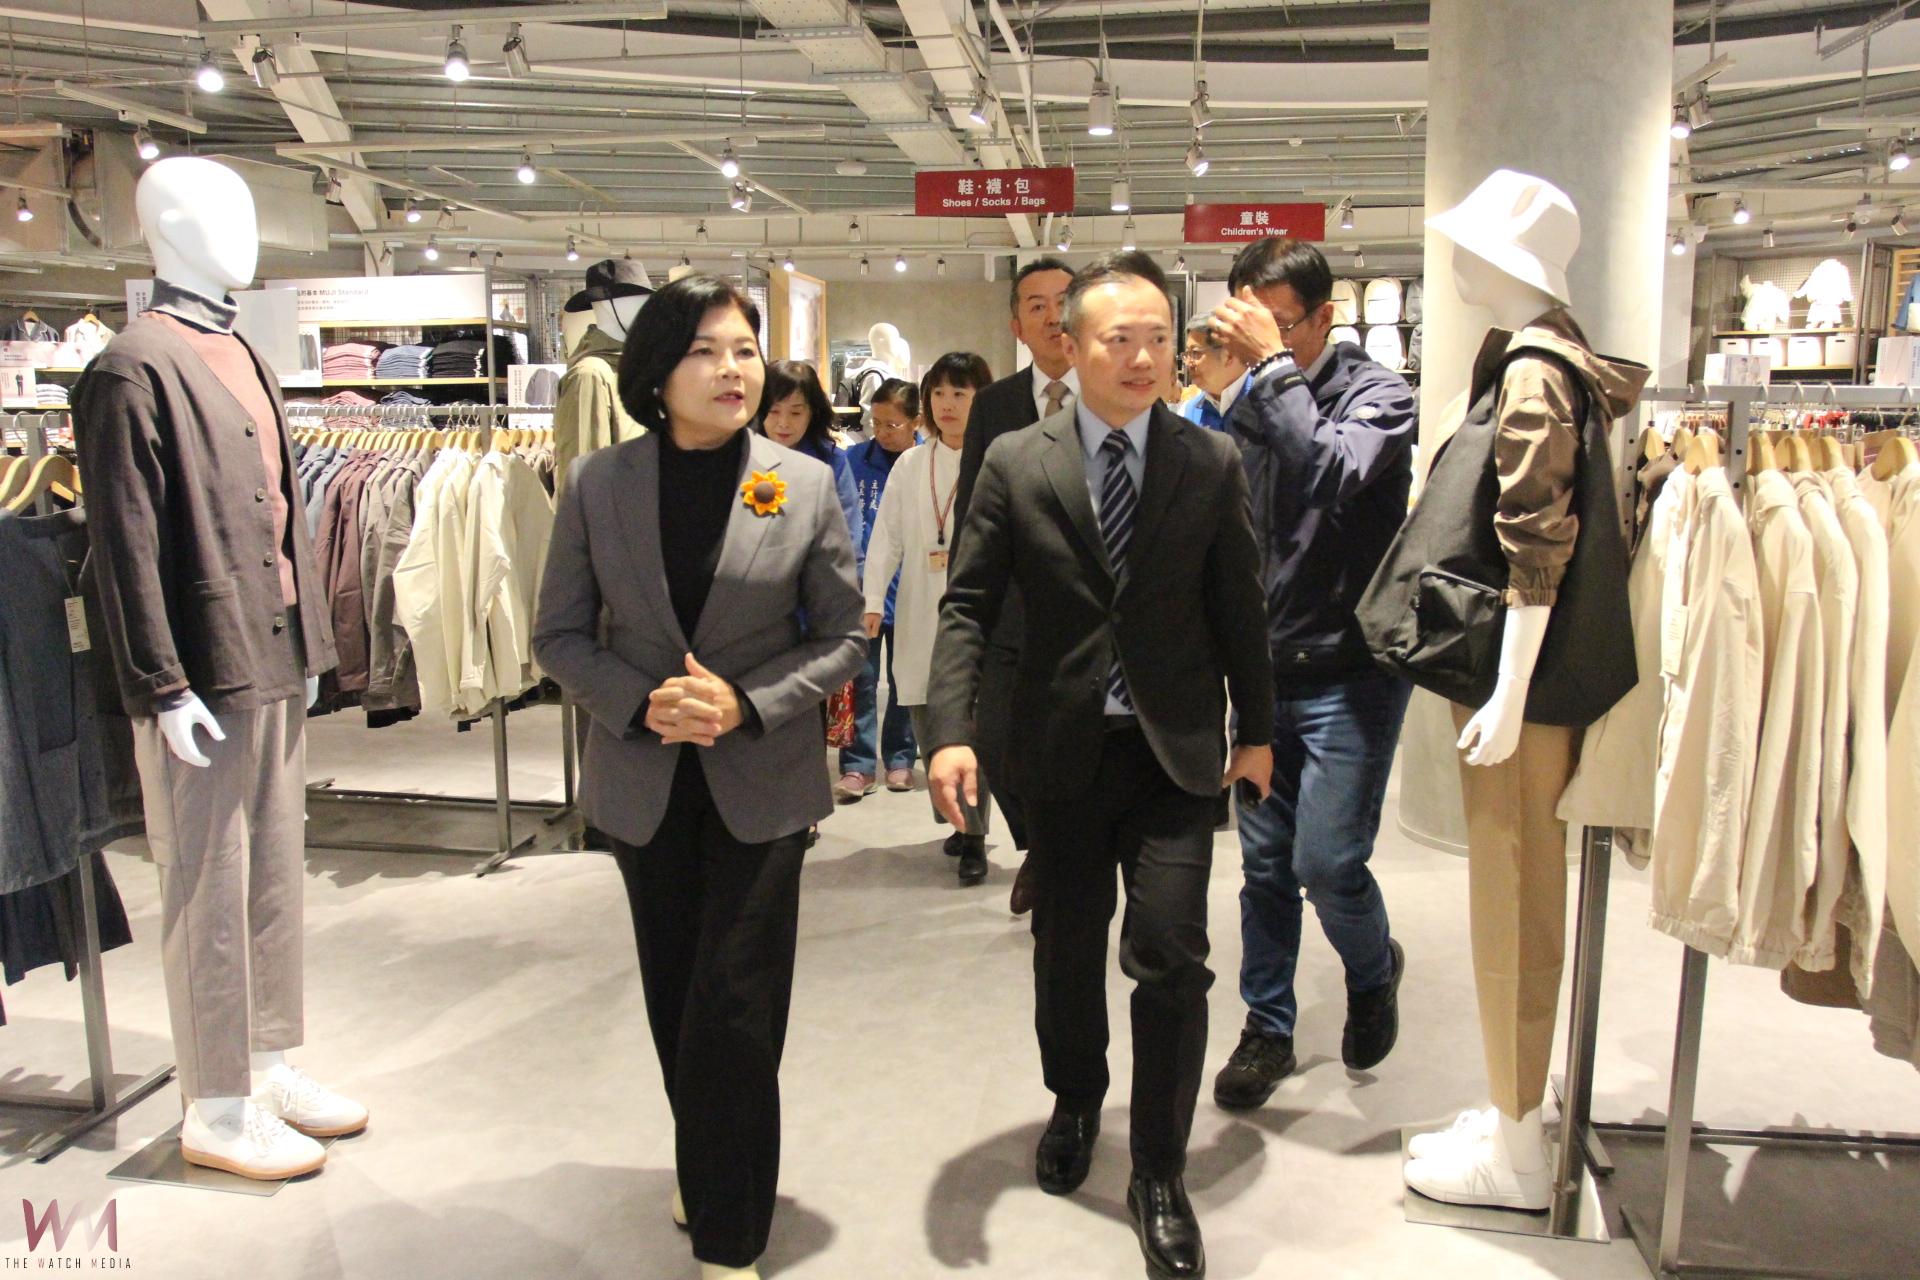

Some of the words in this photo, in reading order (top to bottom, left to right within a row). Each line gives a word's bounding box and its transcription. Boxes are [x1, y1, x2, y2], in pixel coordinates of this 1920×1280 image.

[942, 198, 972, 207] Shoes
[981, 197, 1011, 207] Socks
[1021, 196, 1046, 207] Bags
[1240, 211, 1269, 225] 童裝
[1221, 227, 1264, 236] Children's
[1265, 227, 1288, 236] Wear
